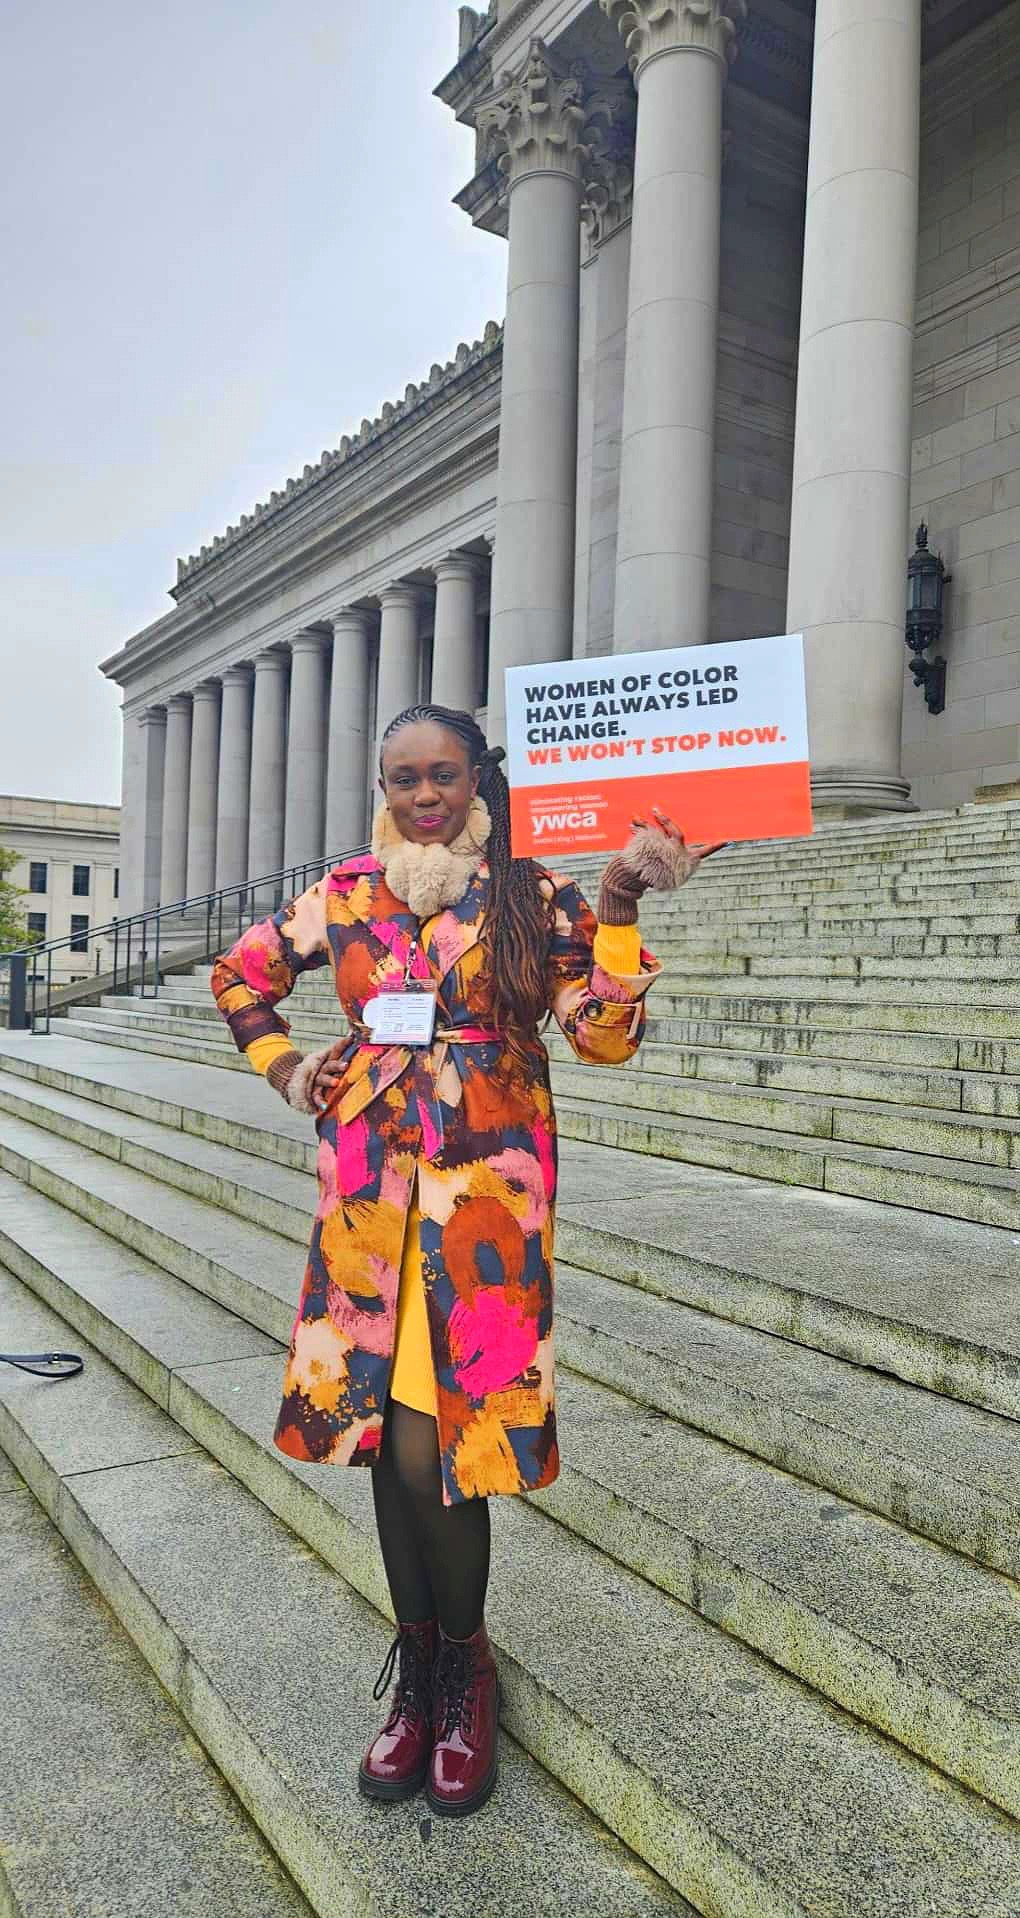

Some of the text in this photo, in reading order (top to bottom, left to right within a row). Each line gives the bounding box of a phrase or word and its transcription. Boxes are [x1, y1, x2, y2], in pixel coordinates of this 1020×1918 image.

[525, 665, 738, 703] WOMEN OF COLOR
[526, 686, 738, 724] HAVE ALWAYS LED
[527, 721, 627, 744] CHANGE.
[528, 726, 787, 766] WE WON'T STOP NOW.
[531, 811, 597, 835] ywca
